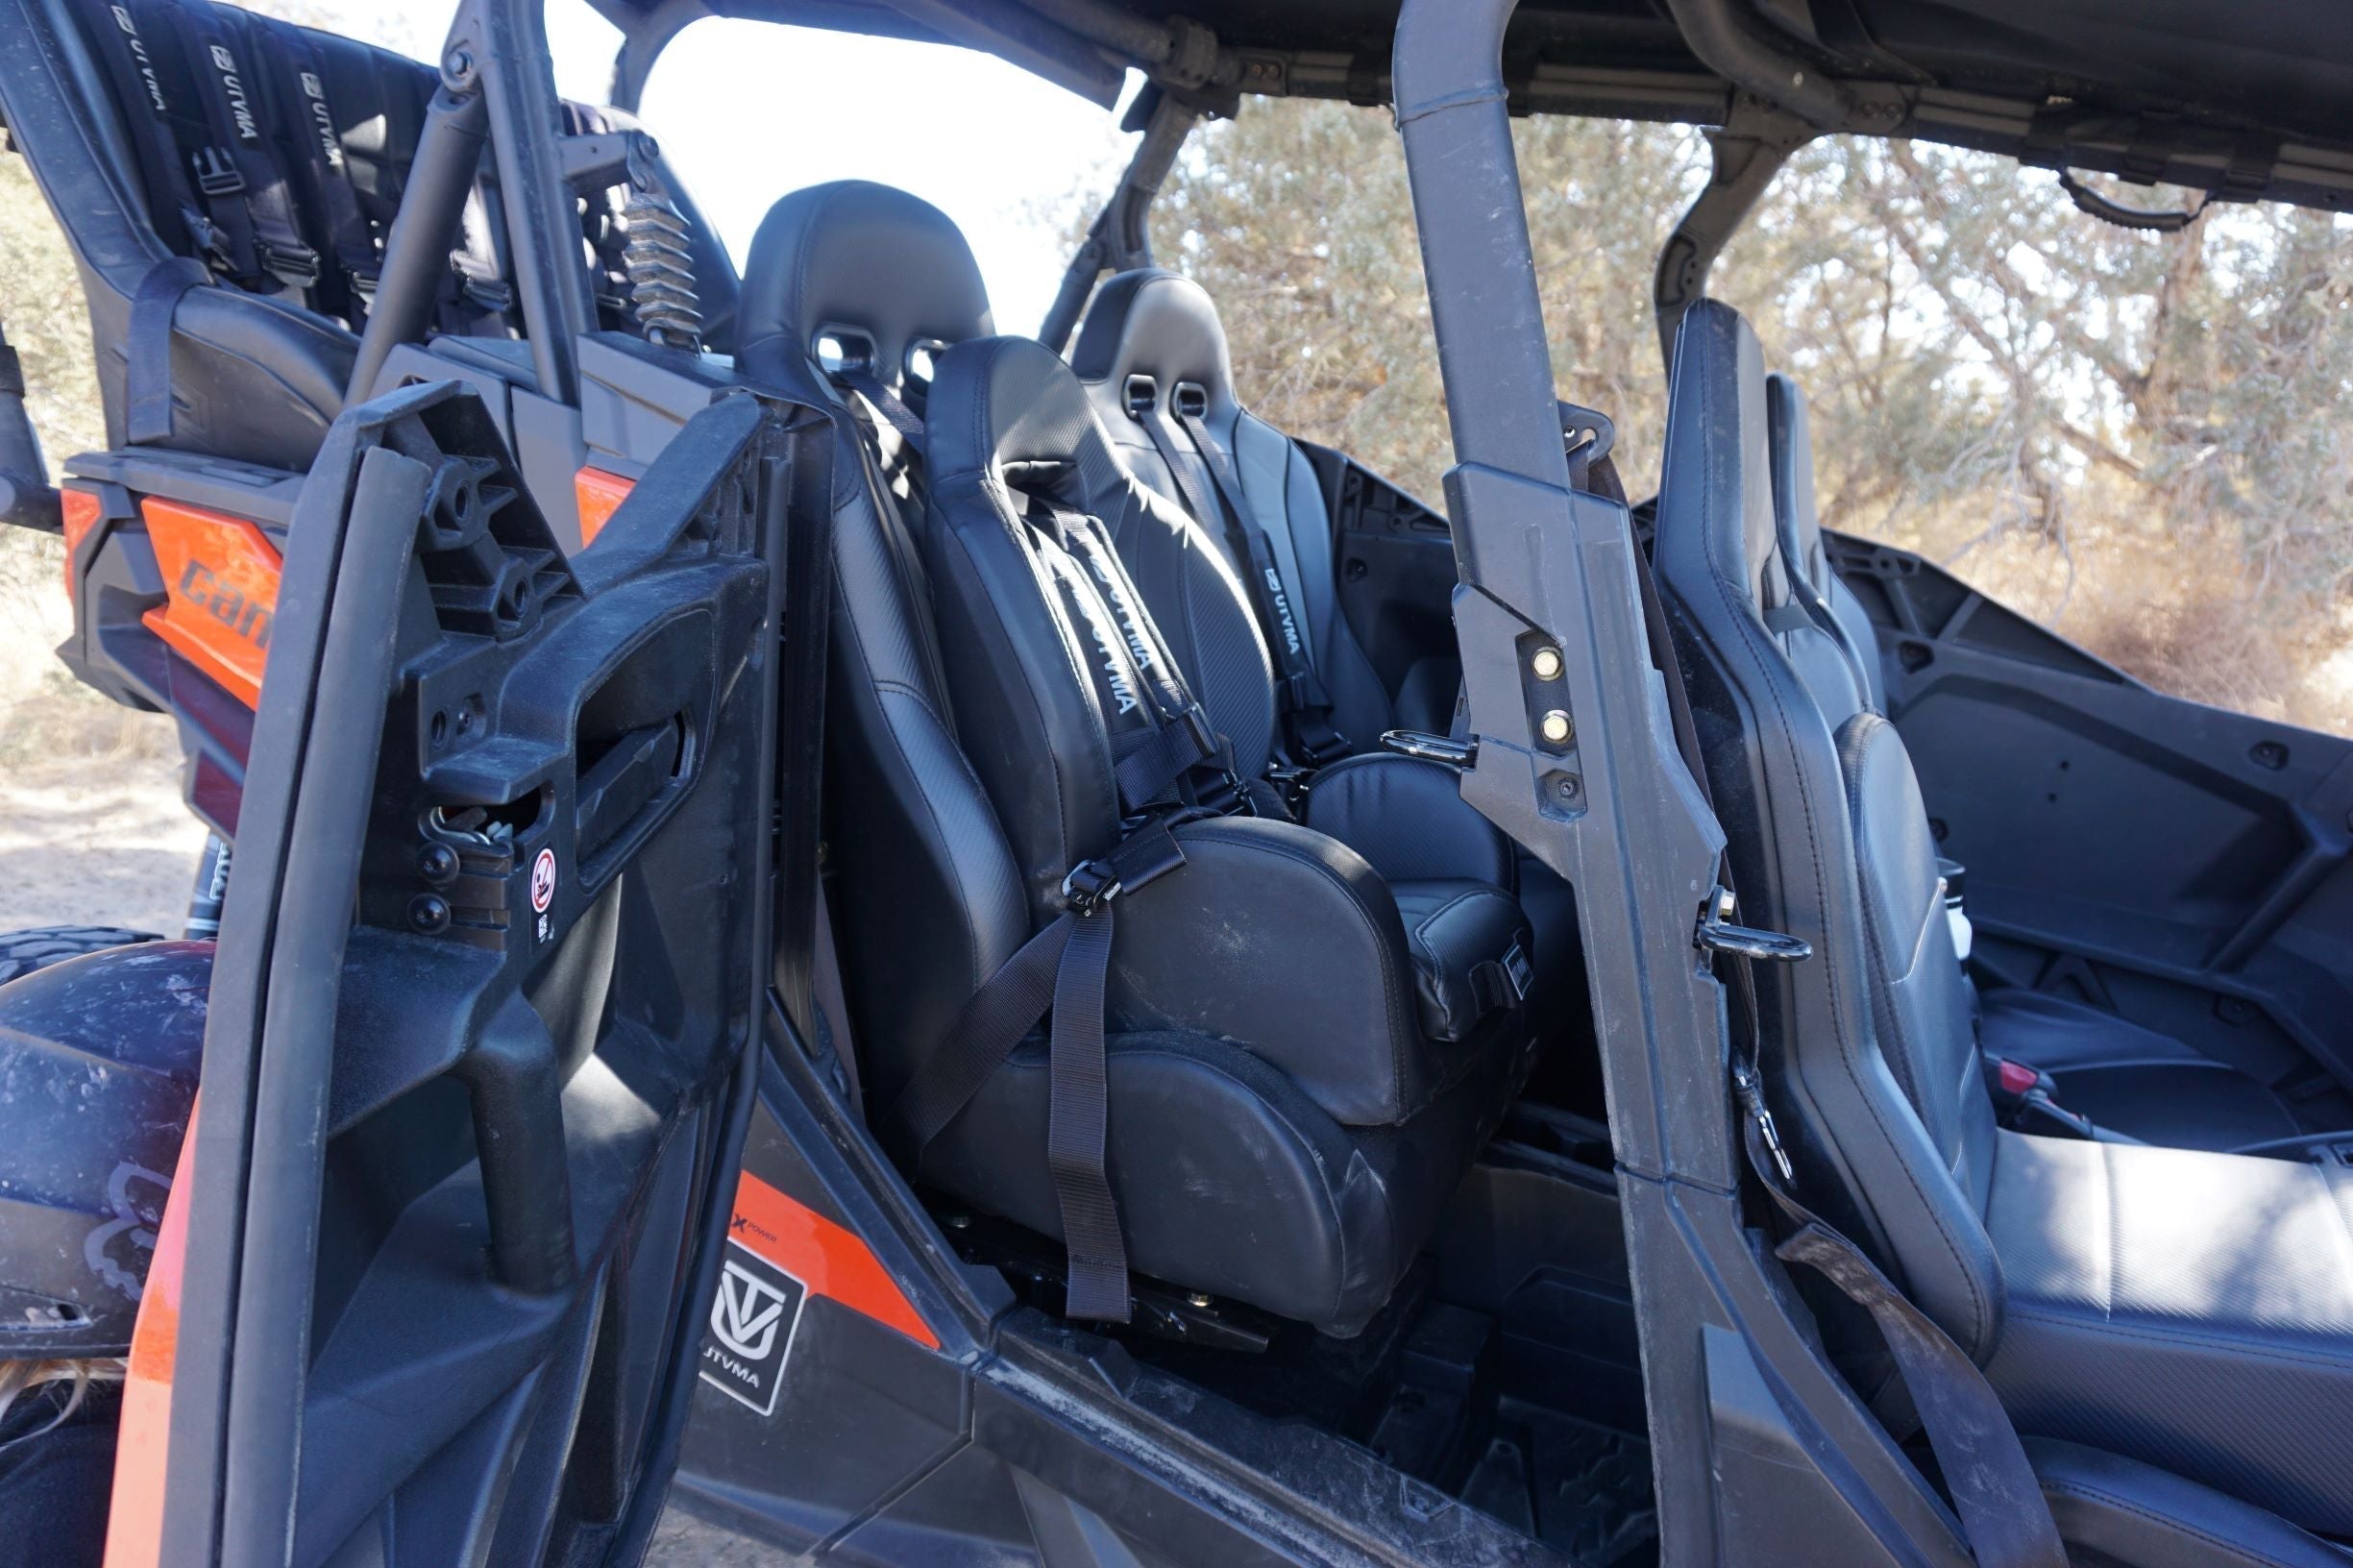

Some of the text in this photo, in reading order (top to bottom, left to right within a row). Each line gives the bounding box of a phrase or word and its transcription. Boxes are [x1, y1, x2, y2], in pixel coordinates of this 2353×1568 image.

[223, 74, 257, 138] UTVMA
[311, 102, 344, 166] UTVMA
[1274, 595, 1300, 654] UTVMA
[748, 1221, 777, 1243] POWER
